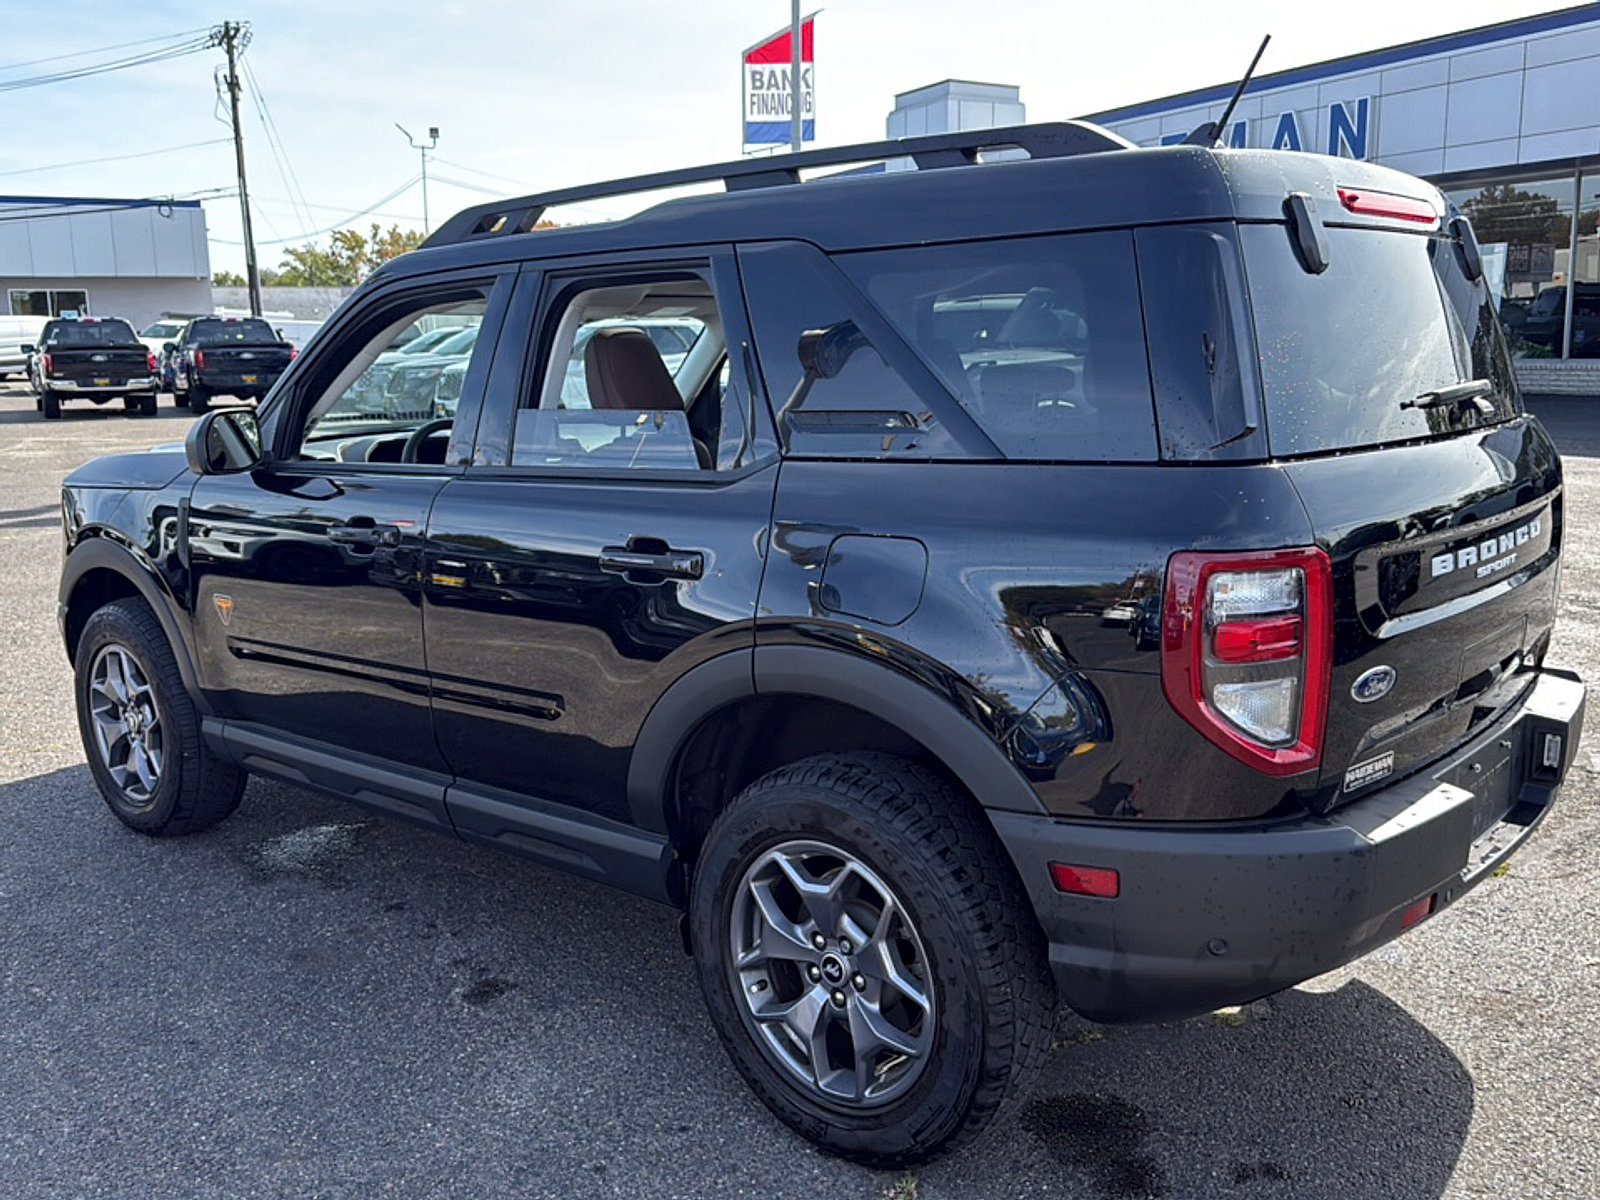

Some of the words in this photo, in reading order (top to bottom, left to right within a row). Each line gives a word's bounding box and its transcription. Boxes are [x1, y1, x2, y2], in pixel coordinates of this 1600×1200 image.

[751, 68, 811, 91] BANK
[750, 91, 812, 116] FINANCG
[1431, 520, 1540, 577] BRONCO
[1477, 552, 1517, 578] SPORT
